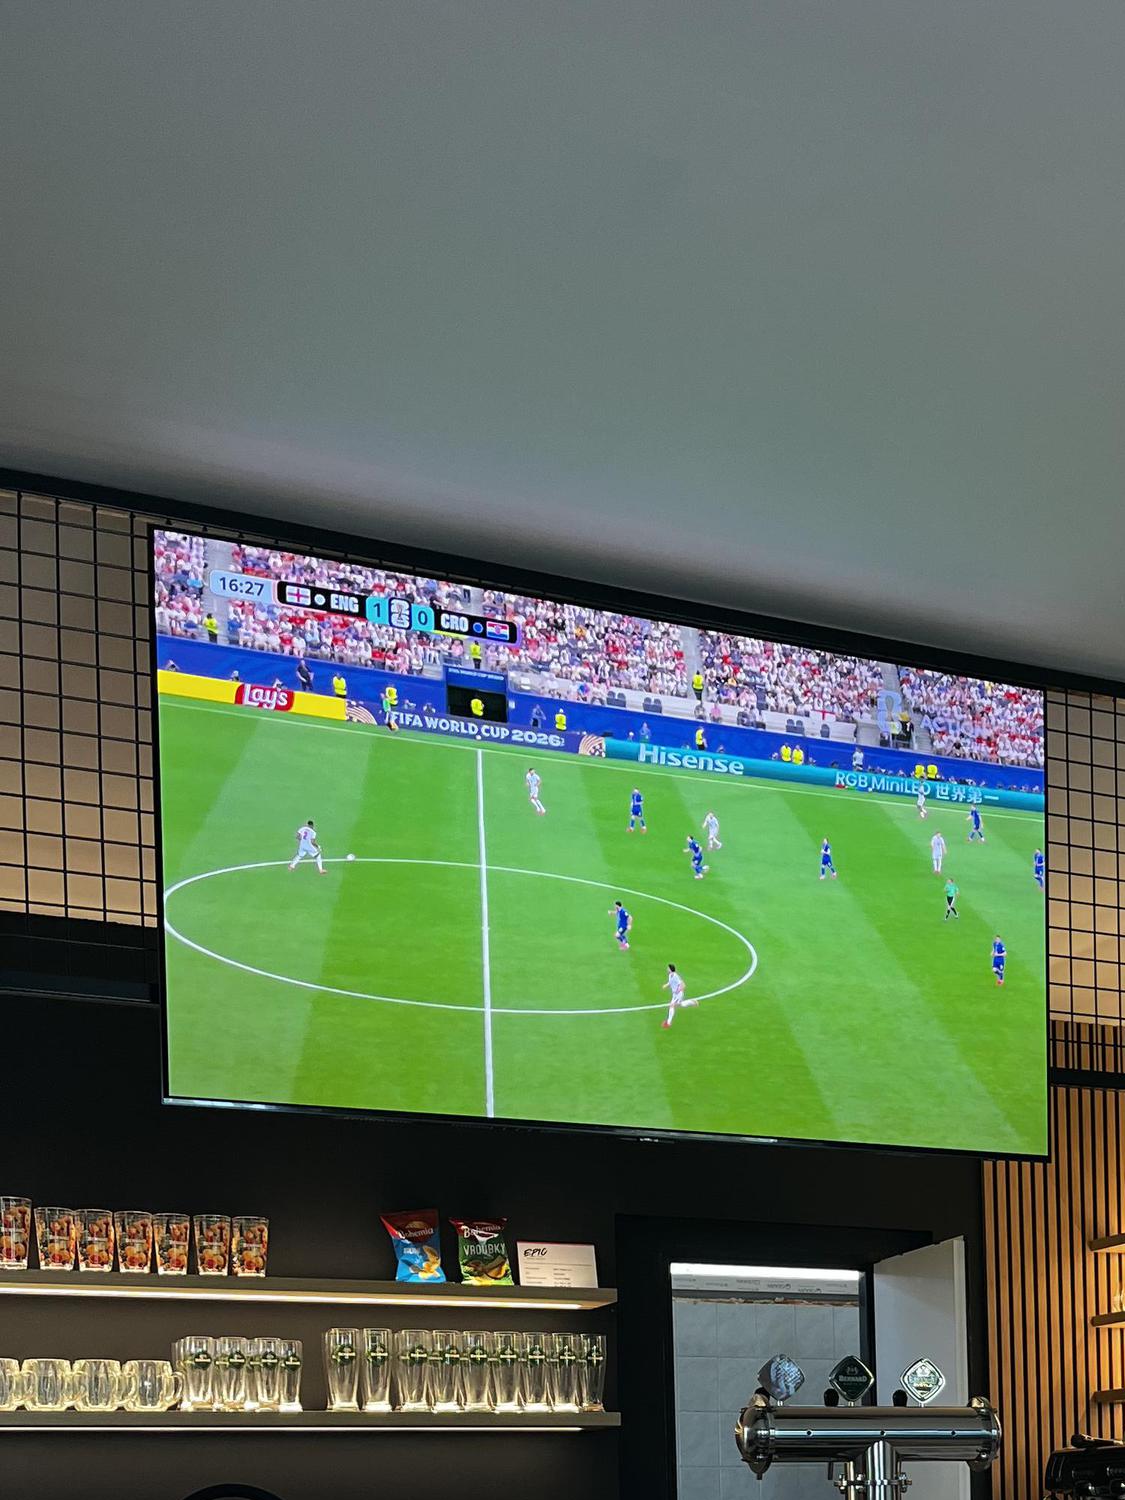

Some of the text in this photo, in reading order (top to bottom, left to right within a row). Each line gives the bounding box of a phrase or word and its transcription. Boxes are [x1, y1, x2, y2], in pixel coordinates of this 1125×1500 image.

[219, 576, 265, 597] 16:27
[330, 593, 360, 613] ENG
[373, 602, 381, 618] 1
[417, 610, 428, 626] 0
[440, 612, 469, 632] CRO
[391, 711, 561, 748] FIFA WORLD CUP 2026
[638, 743, 744, 775] Hisense
[835, 771, 868, 789] RGB
[936, 783, 1000, 804] 世界第一
[463, 1242, 506, 1256] VROUBKY
